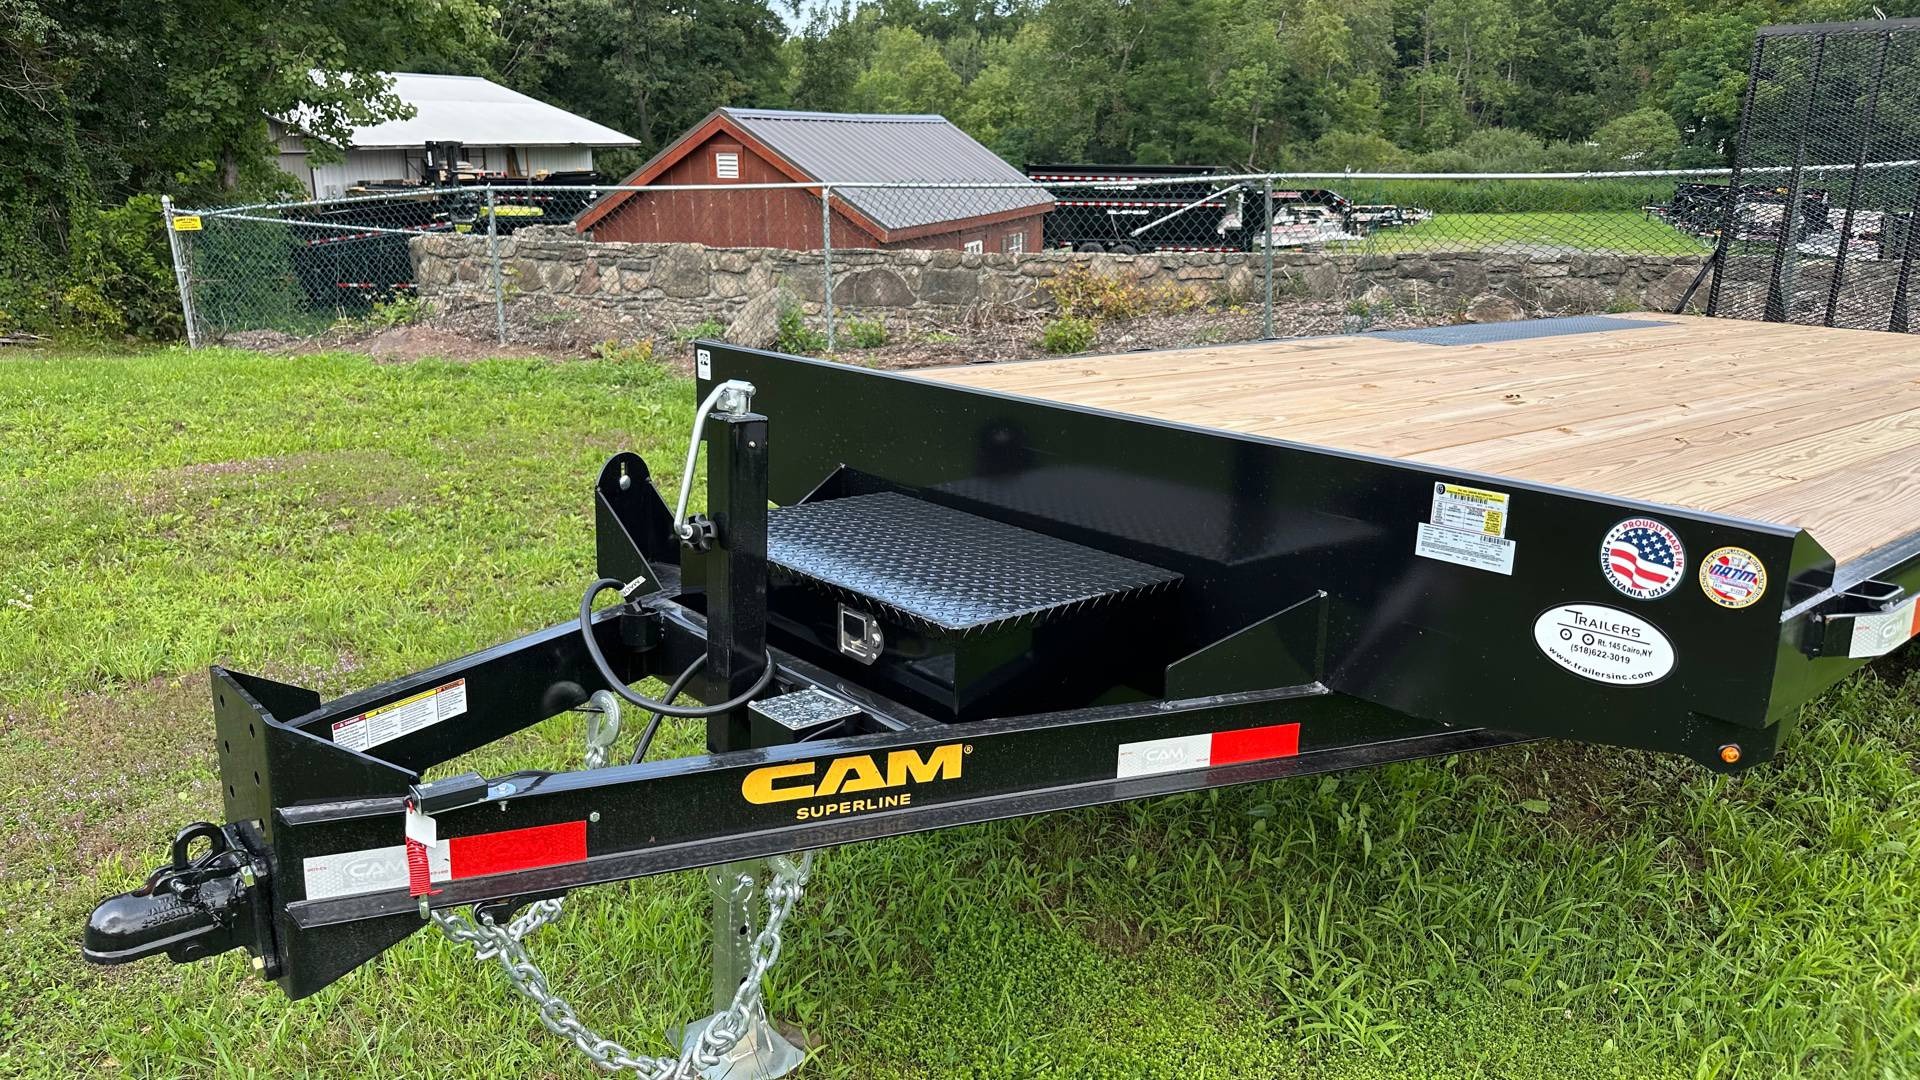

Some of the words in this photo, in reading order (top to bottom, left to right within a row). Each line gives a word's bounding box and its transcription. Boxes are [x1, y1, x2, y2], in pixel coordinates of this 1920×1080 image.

[1622, 519, 1666, 532] PROUDLY
[1664, 531, 1682, 556] MADE
[1675, 557, 1683, 568] IN
[1648, 586, 1667, 597] USA
[1564, 609, 1640, 638] TRAILERS
[1570, 643, 1630, 664] (518)622-3019
[1597, 639, 1607, 648] Rt.
[1609, 641, 1621, 650] 145
[1549, 646, 1654, 681] www.trailersinc.com
[1147, 746, 1184, 761] CAM
[796, 793, 912, 820] SUPERLINE
